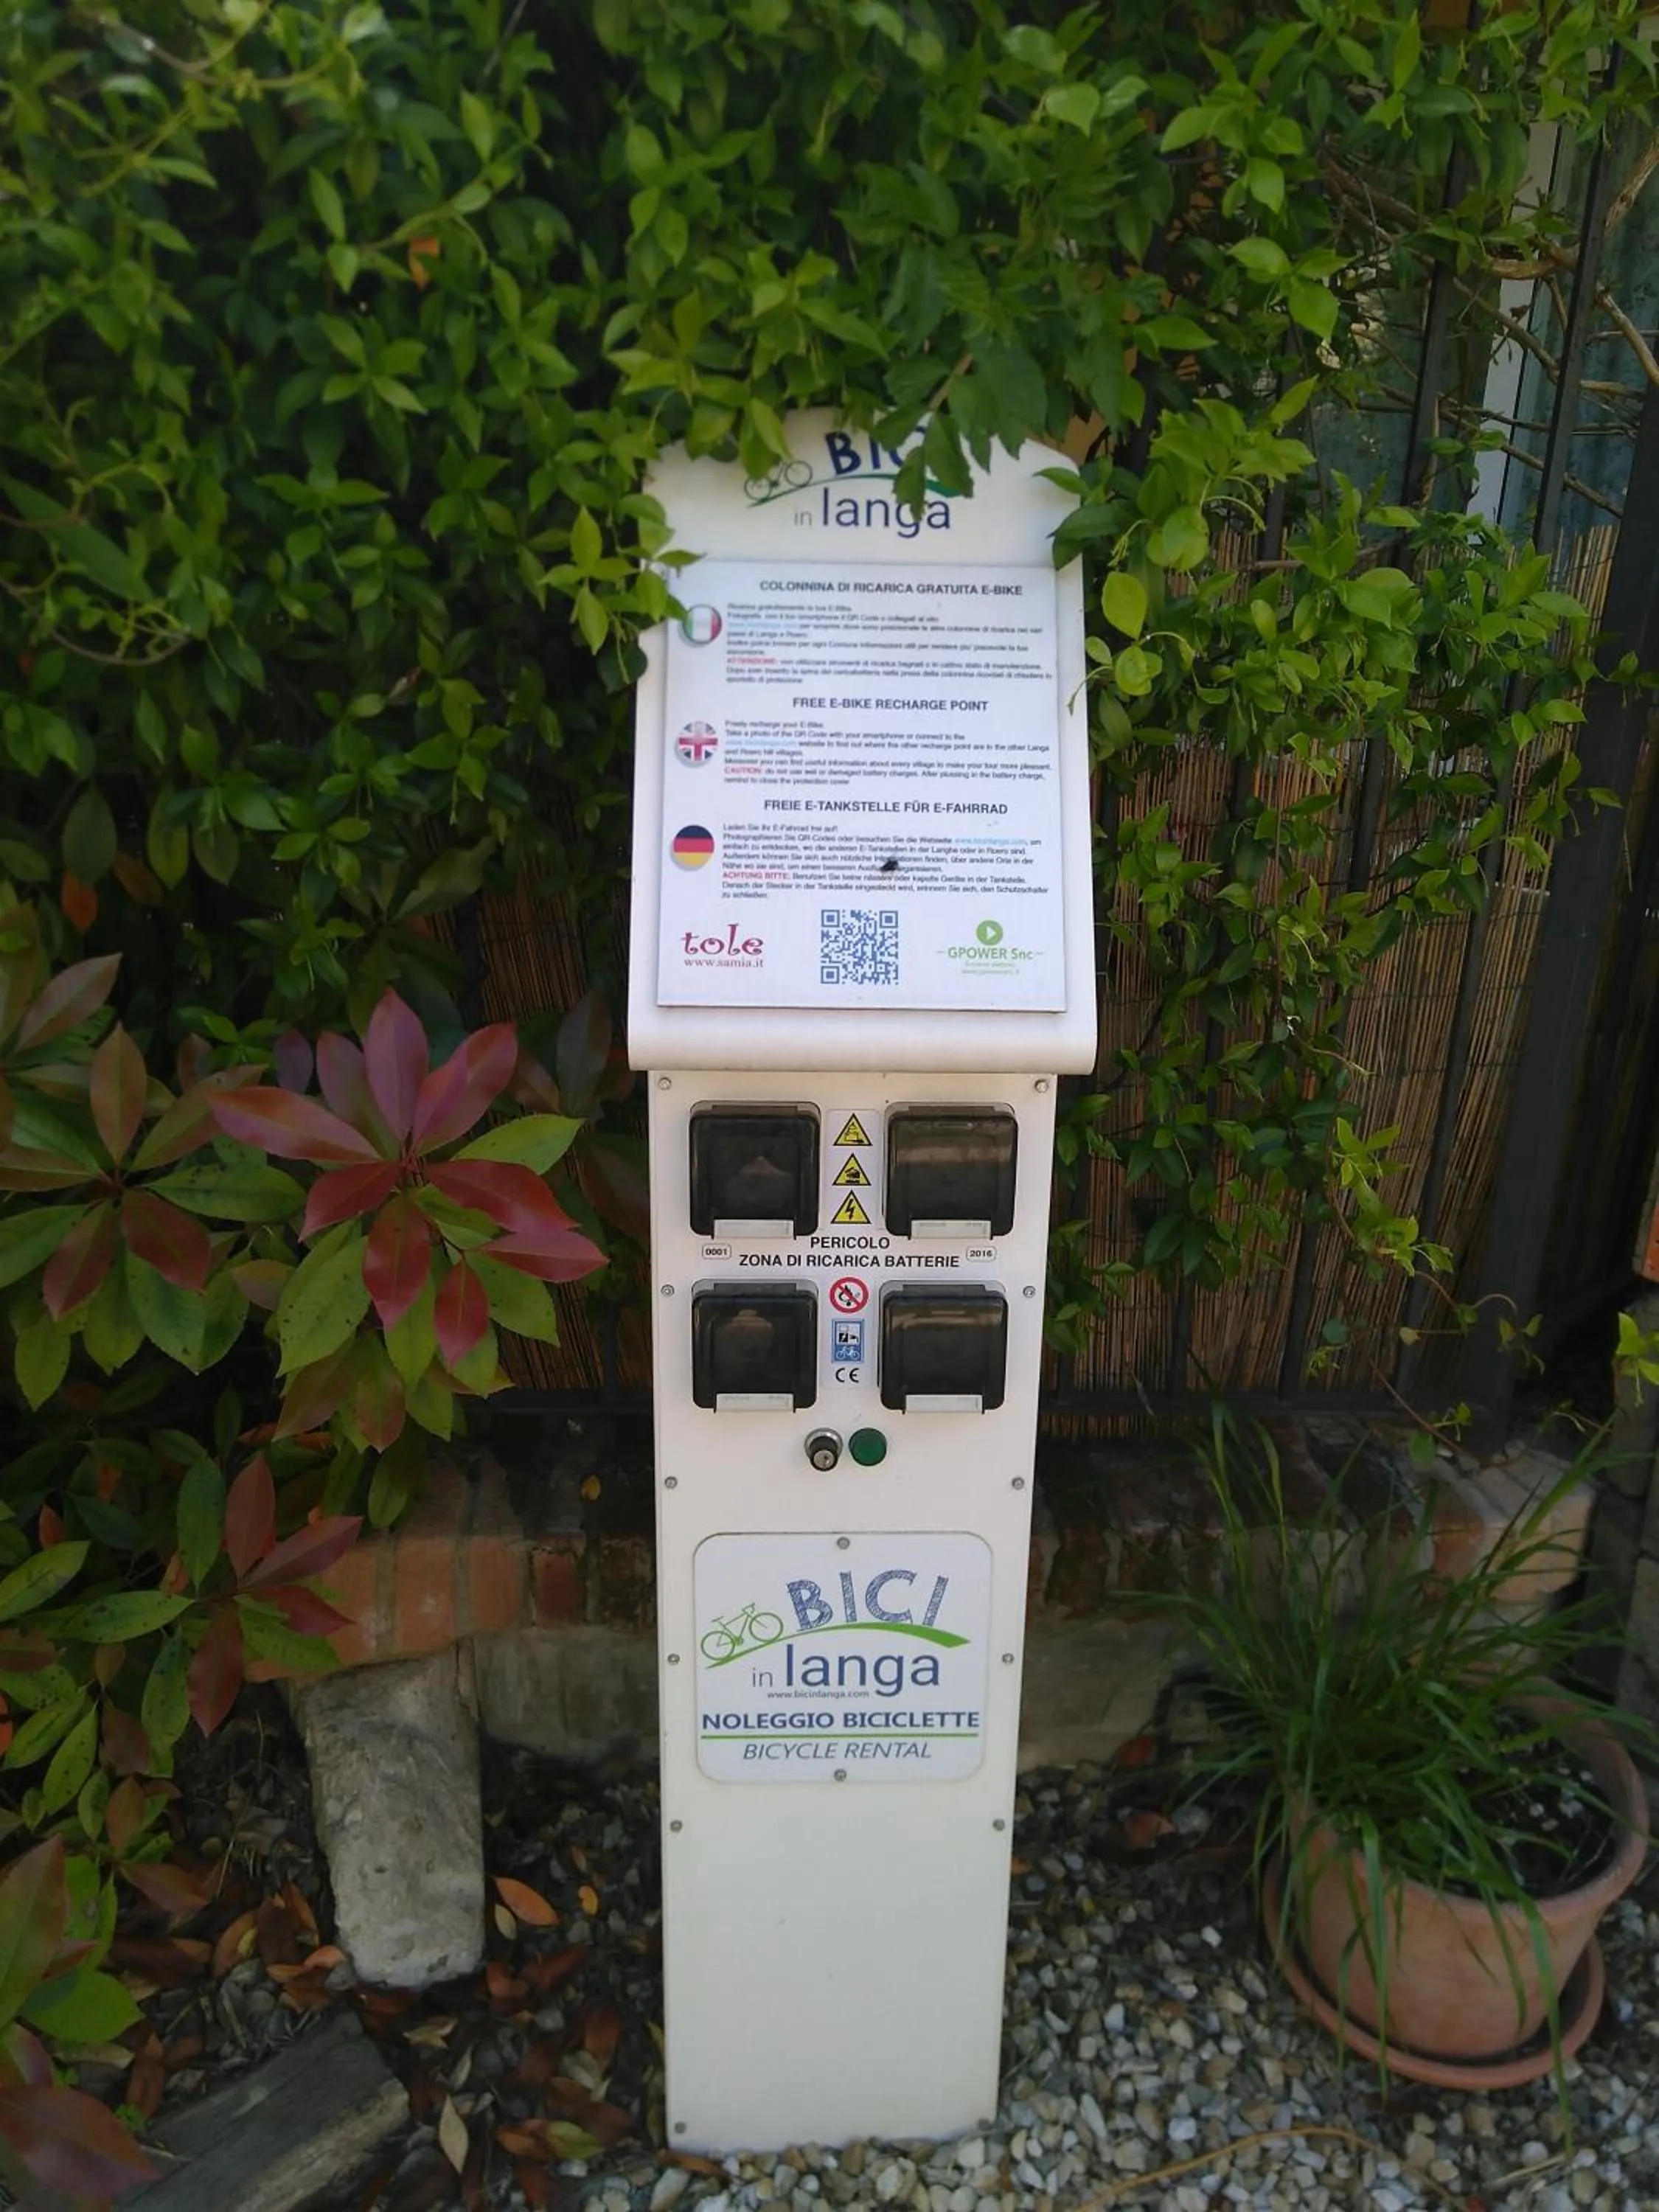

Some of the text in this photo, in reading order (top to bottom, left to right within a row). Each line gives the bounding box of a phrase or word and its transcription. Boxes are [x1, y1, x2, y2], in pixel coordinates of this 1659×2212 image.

[793, 487, 951, 539] in langa
[760, 580, 1023, 595] COLONNINA DI RICARICA GRATUITA E-BIKE
[793, 697, 989, 711] FREE E-BIKE RECHARGE POINT
[764, 800, 1009, 814] FREIE E-TANKSTELLE FÜR E-FAHRRAD
[681, 923, 764, 956] tole
[947, 947, 1034, 960] GPOWER Snc
[683, 957, 764, 969] www.samia.it
[810, 1237, 891, 1249] PERICOLO
[739, 1255, 960, 1267] ZONA DI RICARICA BATTERIE
[835, 1368, 860, 1383] CE
[785, 1569, 949, 1632] BICI
[752, 1644, 939, 1697] in langa
[767, 1689, 869, 1699] www.bicinlanga.com
[702, 1711, 979, 1730] NOLEGGIO BICICLETTE
[742, 1742, 931, 1760] BICYCLE RENTAL
